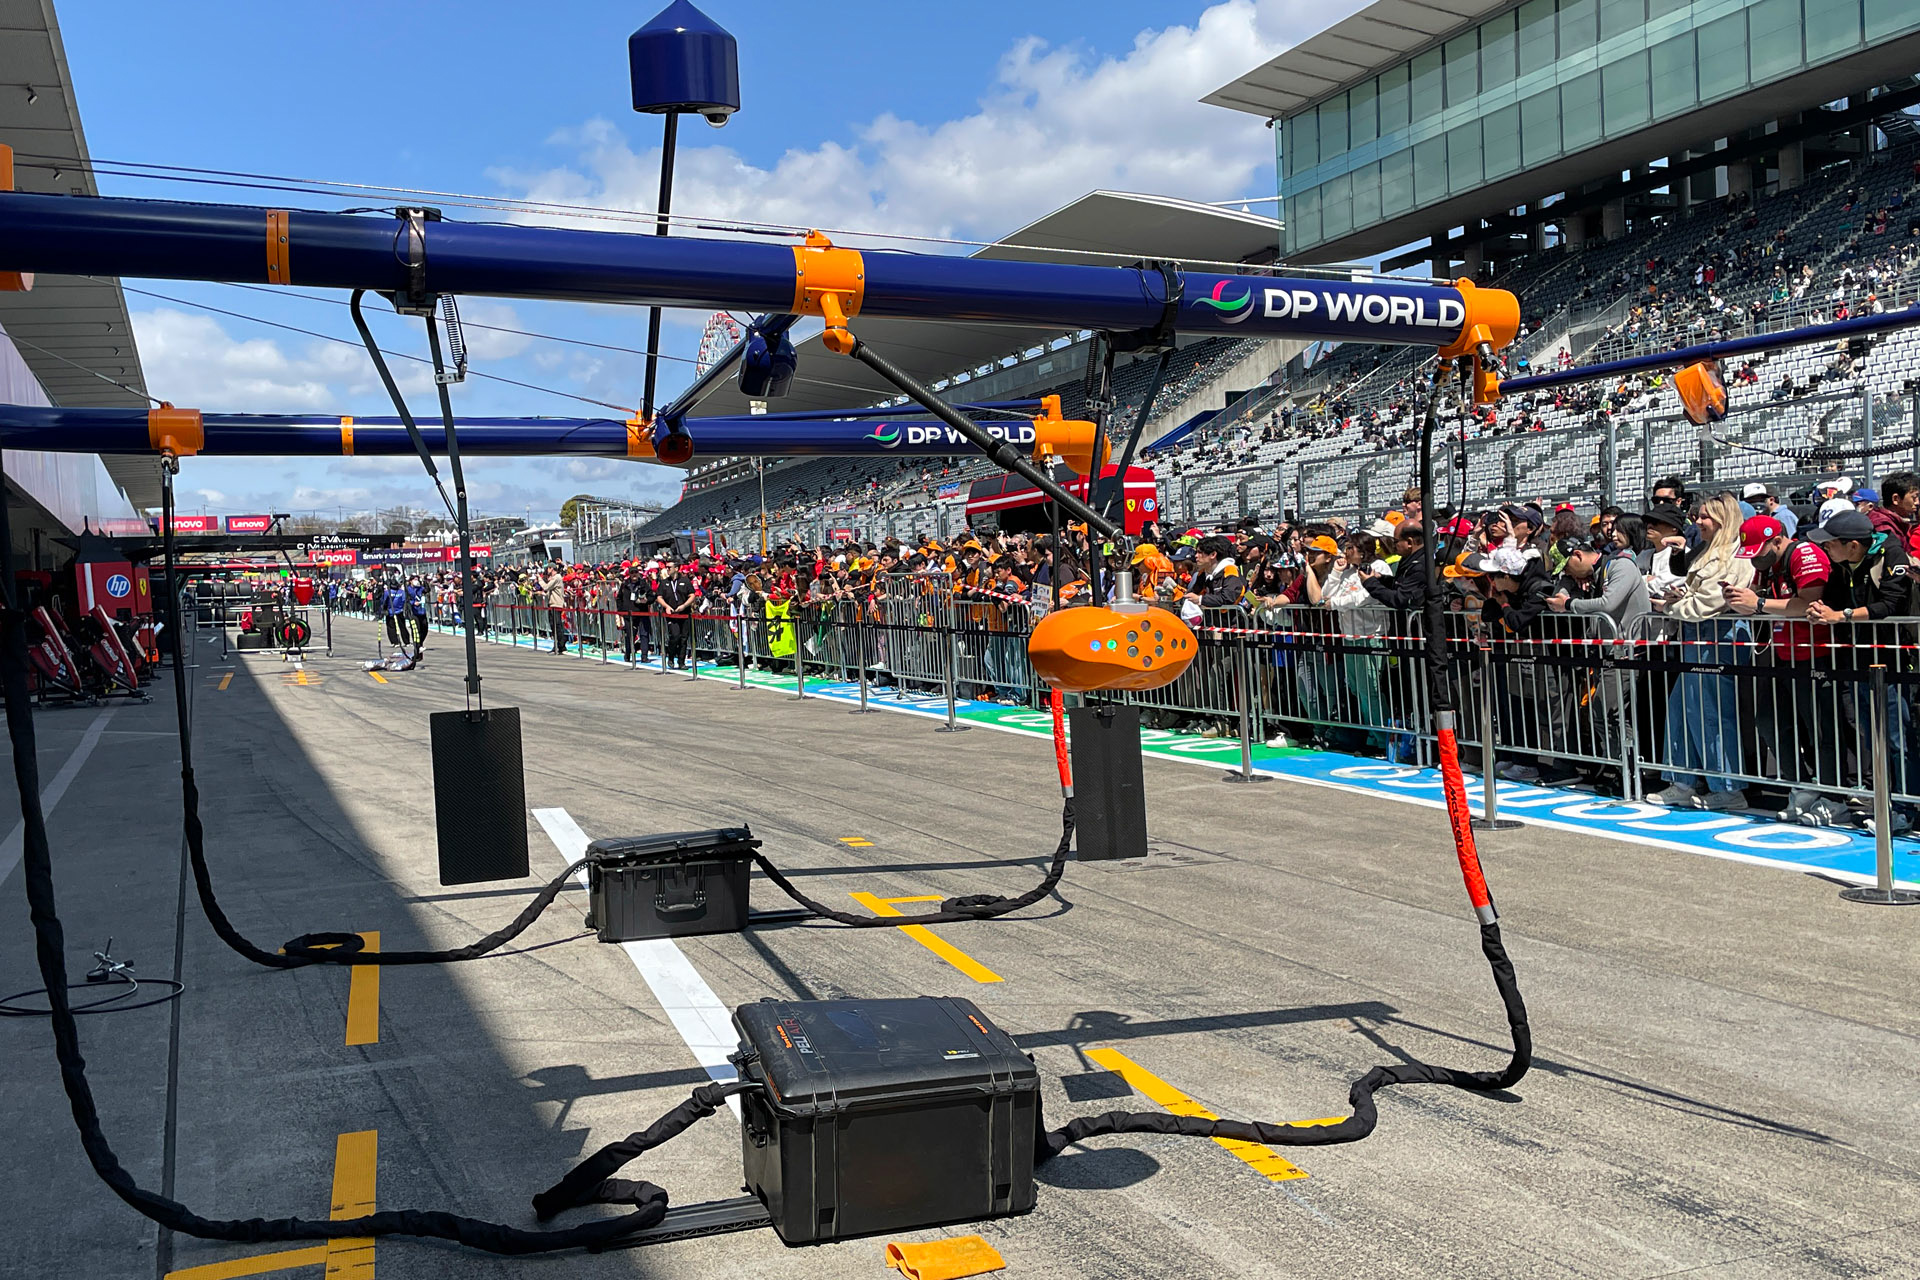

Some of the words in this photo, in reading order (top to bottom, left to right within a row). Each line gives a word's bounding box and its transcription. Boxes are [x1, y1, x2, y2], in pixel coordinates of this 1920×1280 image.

[1263, 288, 1318, 319] DP
[1322, 291, 1466, 328] WORLD
[907, 426, 942, 445] DP
[945, 426, 1036, 445] WRLD
[1145, 498, 1155, 511] hp
[169, 519, 203, 528] enovo
[231, 520, 265, 528] Lenovo
[313, 535, 341, 543] CEVA
[110, 575, 128, 597] hp
[1446, 783, 1465, 848] McLaren
[793, 1035, 814, 1054] PELI
